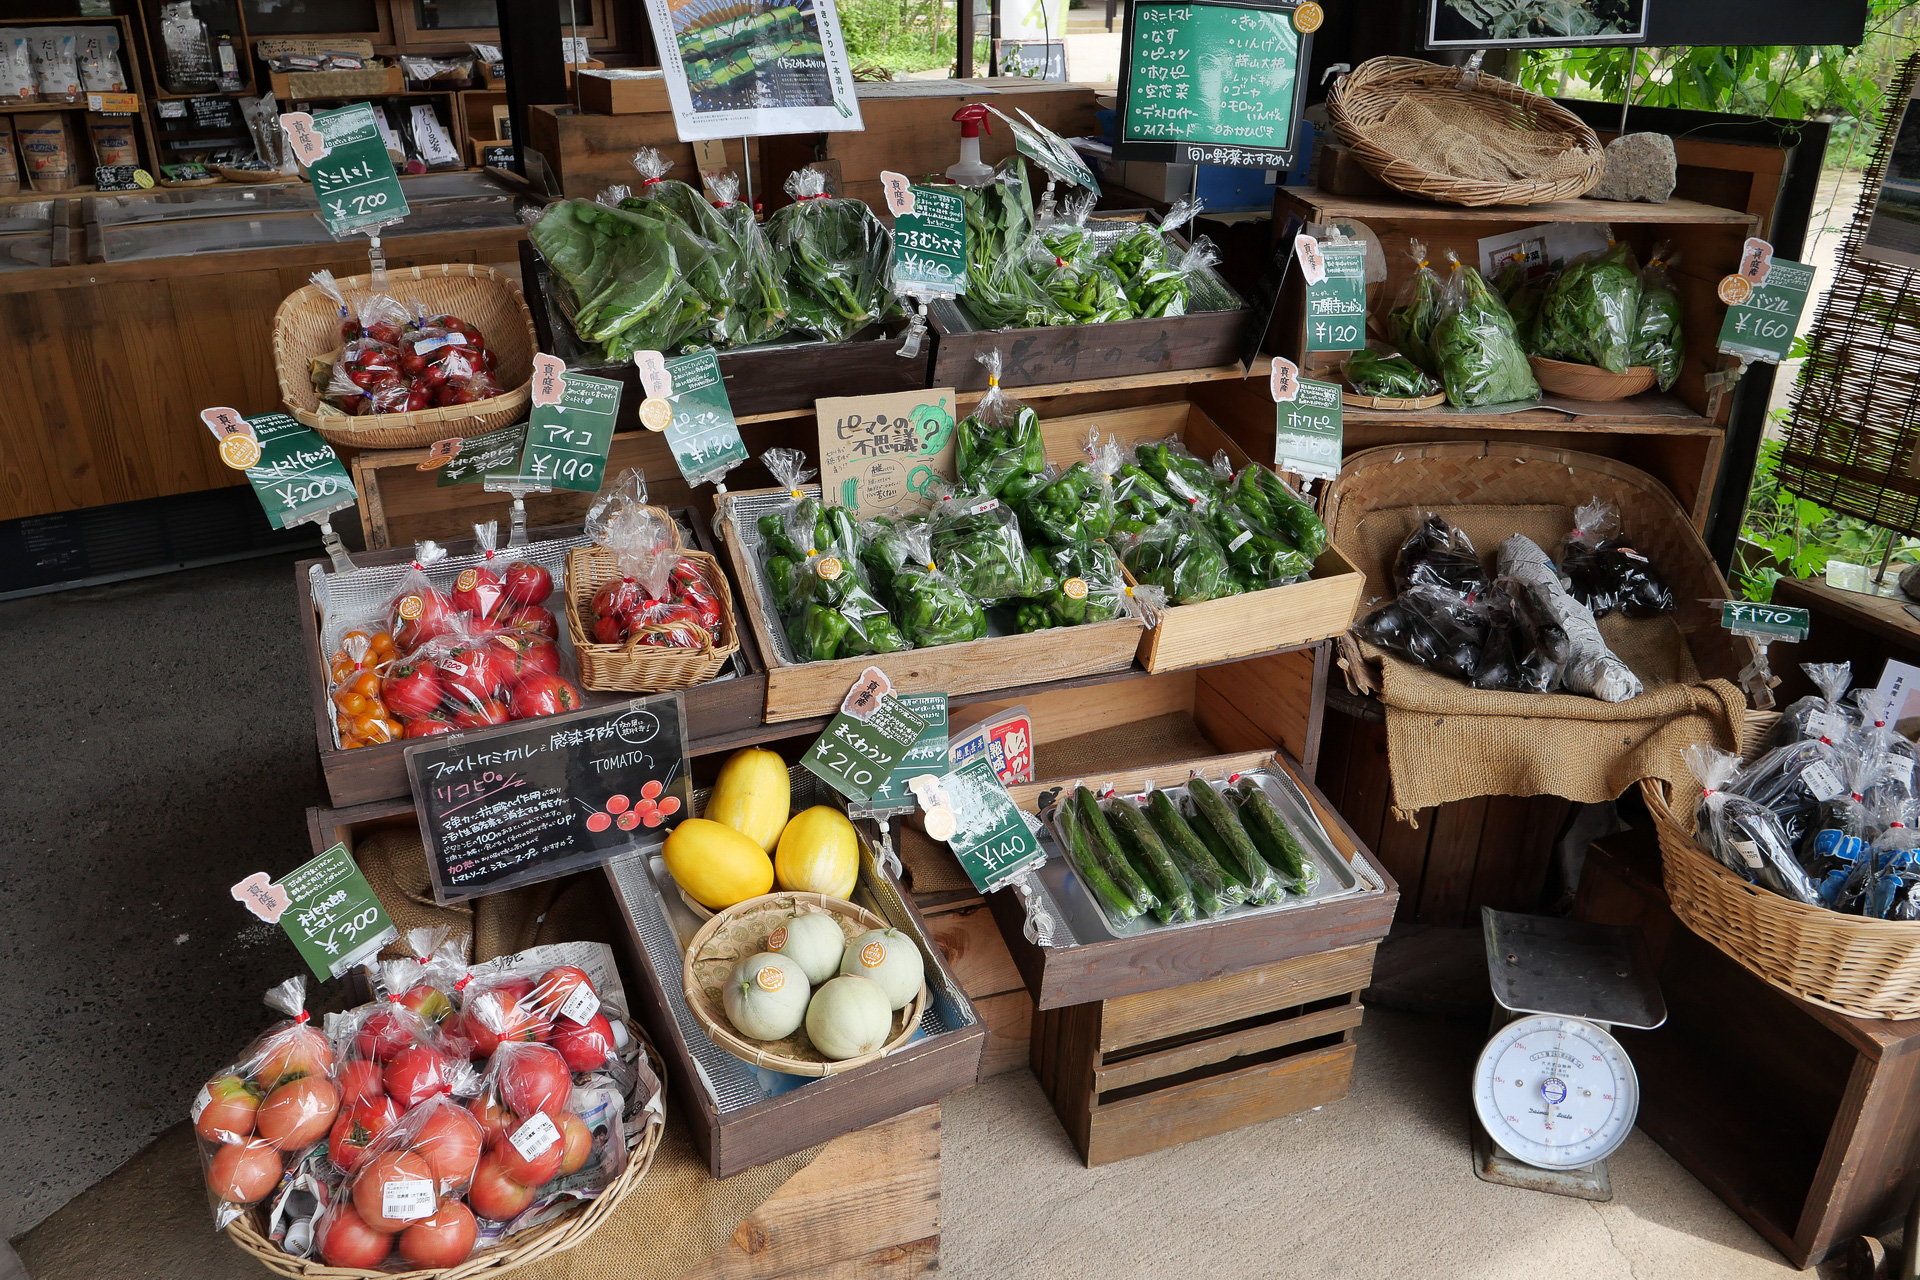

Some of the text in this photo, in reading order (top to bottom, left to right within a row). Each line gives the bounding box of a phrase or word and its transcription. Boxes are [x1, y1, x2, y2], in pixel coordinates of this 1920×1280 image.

[1150, 9, 1193, 22] ミニトマト
[1151, 28, 1179, 44] なす
[1236, 36, 1287, 52] いんげん
[1150, 46, 1190, 61] ピーマン
[1234, 53, 1286, 70] 蒜山大根
[1145, 83, 1190, 100] 空芯菜
[1231, 84, 1261, 97] ゴーヤ
[1142, 104, 1199, 119] デストロイヤー
[1228, 101, 1264, 112] モロッコ
[1246, 109, 1284, 122] いんげん
[292, 120, 315, 154] 真庭産
[1143, 123, 1196, 138] スイスチャード
[317, 160, 375, 190] ミニトマト
[897, 231, 963, 256] つるむらさき
[904, 252, 952, 279] ¥120
[1748, 247, 1764, 277] 真庭産
[1311, 298, 1364, 315] 万願寺とうがらし
[1746, 293, 1790, 312] バジル
[1315, 322, 1358, 344] ¥120
[1735, 312, 1788, 338] ¥160
[542, 362, 555, 396] 真庭産
[1280, 366, 1290, 392] 真庭産
[672, 411, 720, 435] ピーマン
[836, 413, 910, 440] ピーマンの
[1287, 412, 1336, 430] ホクピー
[543, 424, 593, 446] アイコ
[852, 427, 919, 457] 不思議
[685, 433, 733, 464] ¥130
[531, 452, 594, 481] ¥190
[275, 476, 338, 510] ¥200
[854, 679, 880, 707] 真庭産
[833, 722, 892, 764] まくわうり
[590, 750, 643, 774] TOMATO
[815, 739, 873, 786] ¥210
[975, 834, 1027, 871] ¥140
[247, 882, 277, 911] 真庭産
[296, 889, 348, 928] 桃太郎
[304, 912, 338, 938] トマト
[314, 906, 379, 956] ¥300
